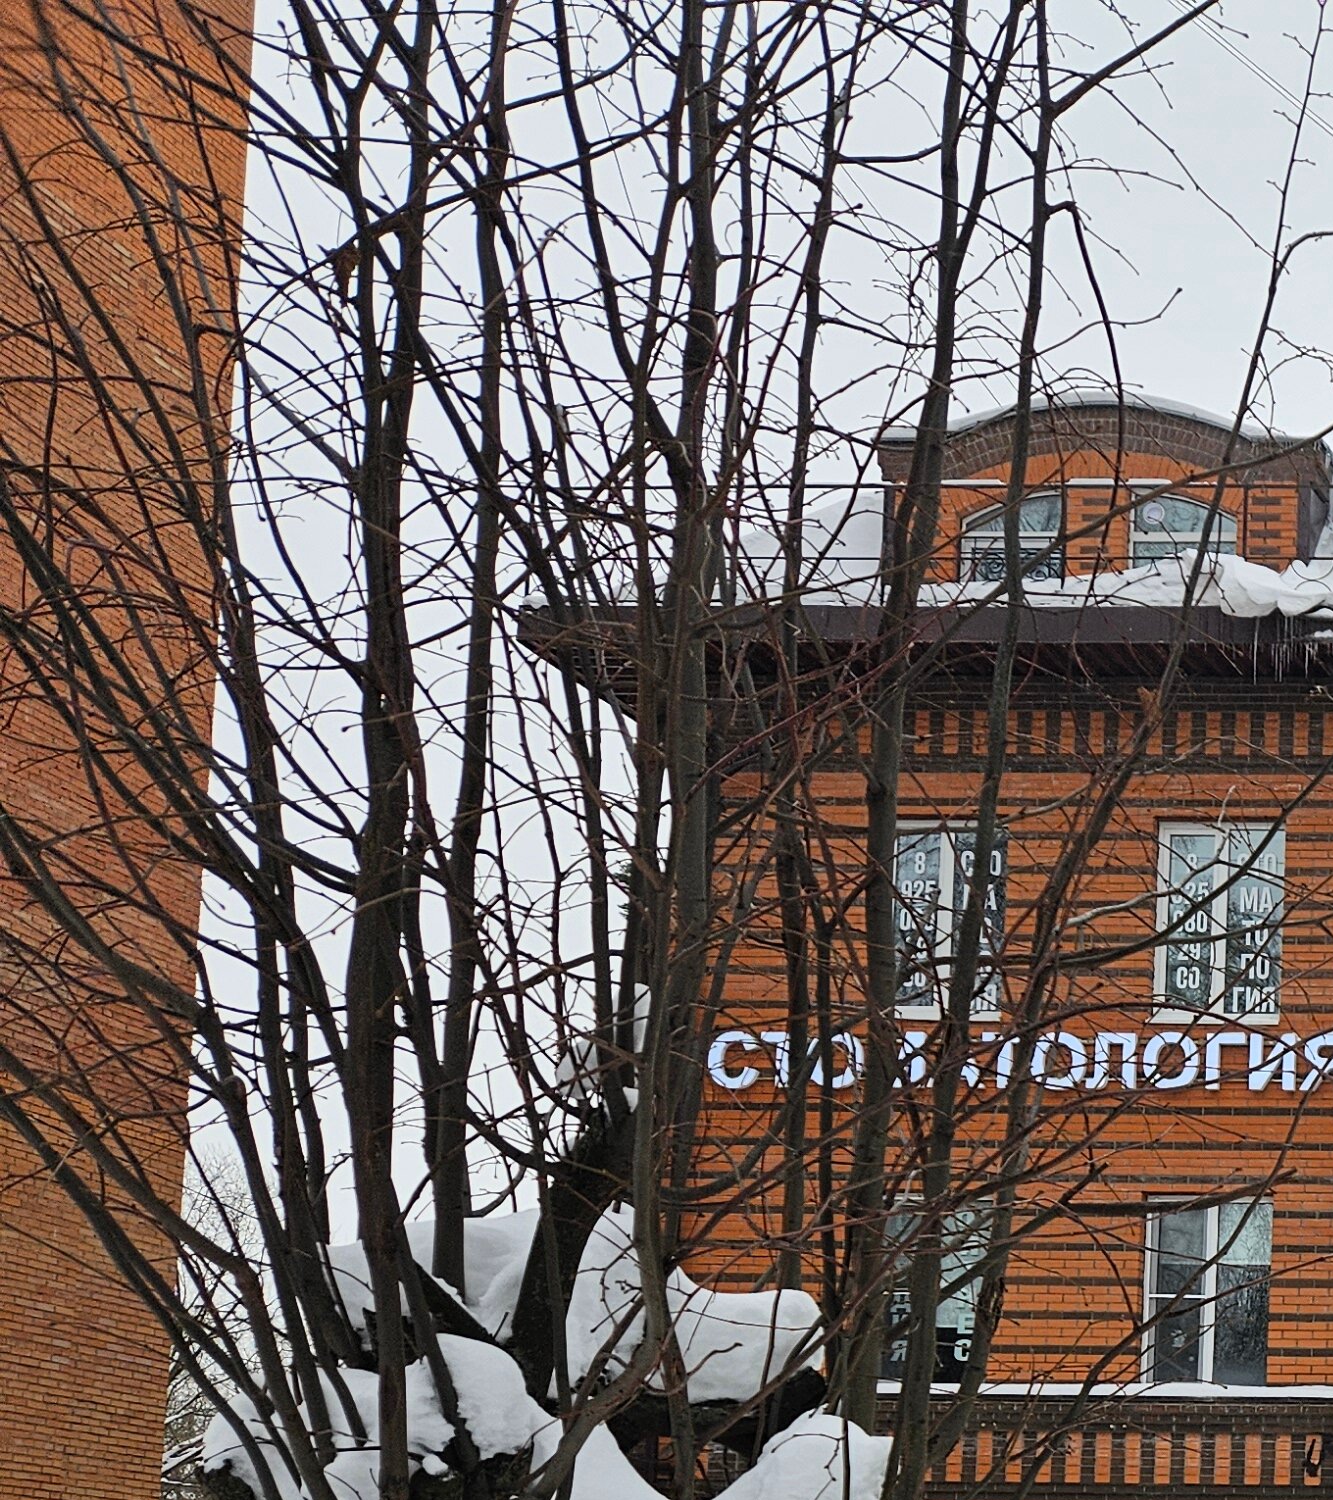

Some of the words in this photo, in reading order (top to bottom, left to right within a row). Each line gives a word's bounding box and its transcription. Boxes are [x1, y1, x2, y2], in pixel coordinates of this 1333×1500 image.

[914, 851, 926, 875] 8
[960, 850, 1001, 877] СО
[1239, 886, 1274, 913] МА
[1241, 920, 1270, 946] ТО
[1232, 986, 1276, 1013] ГИЯ
